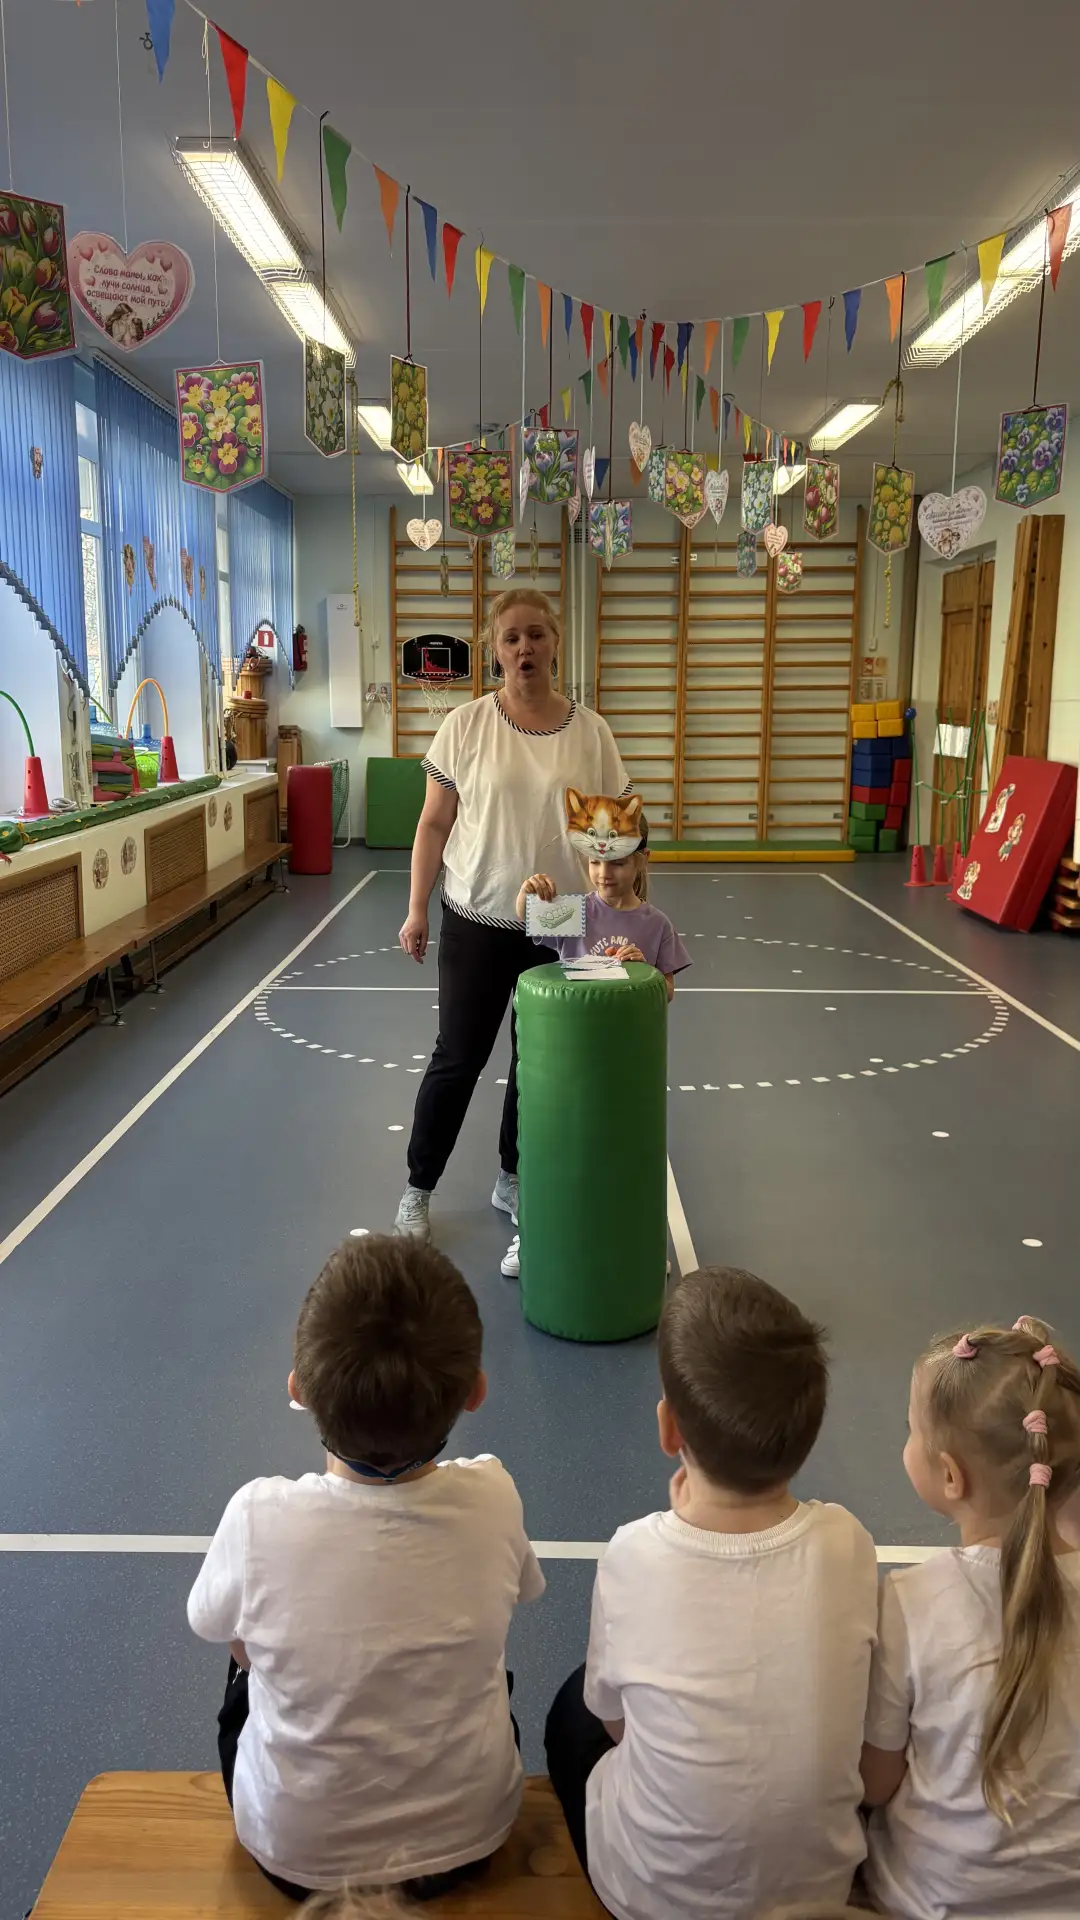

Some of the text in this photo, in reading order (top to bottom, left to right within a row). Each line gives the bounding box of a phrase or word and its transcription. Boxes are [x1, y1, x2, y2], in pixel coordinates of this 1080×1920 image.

[94, 265, 162, 282] Слова мамы, как
[102, 280, 120, 289] лучи
[86, 290, 128, 301] освещают
[130, 295, 146, 304] мой
[590, 936, 628, 956] CUTE AND
